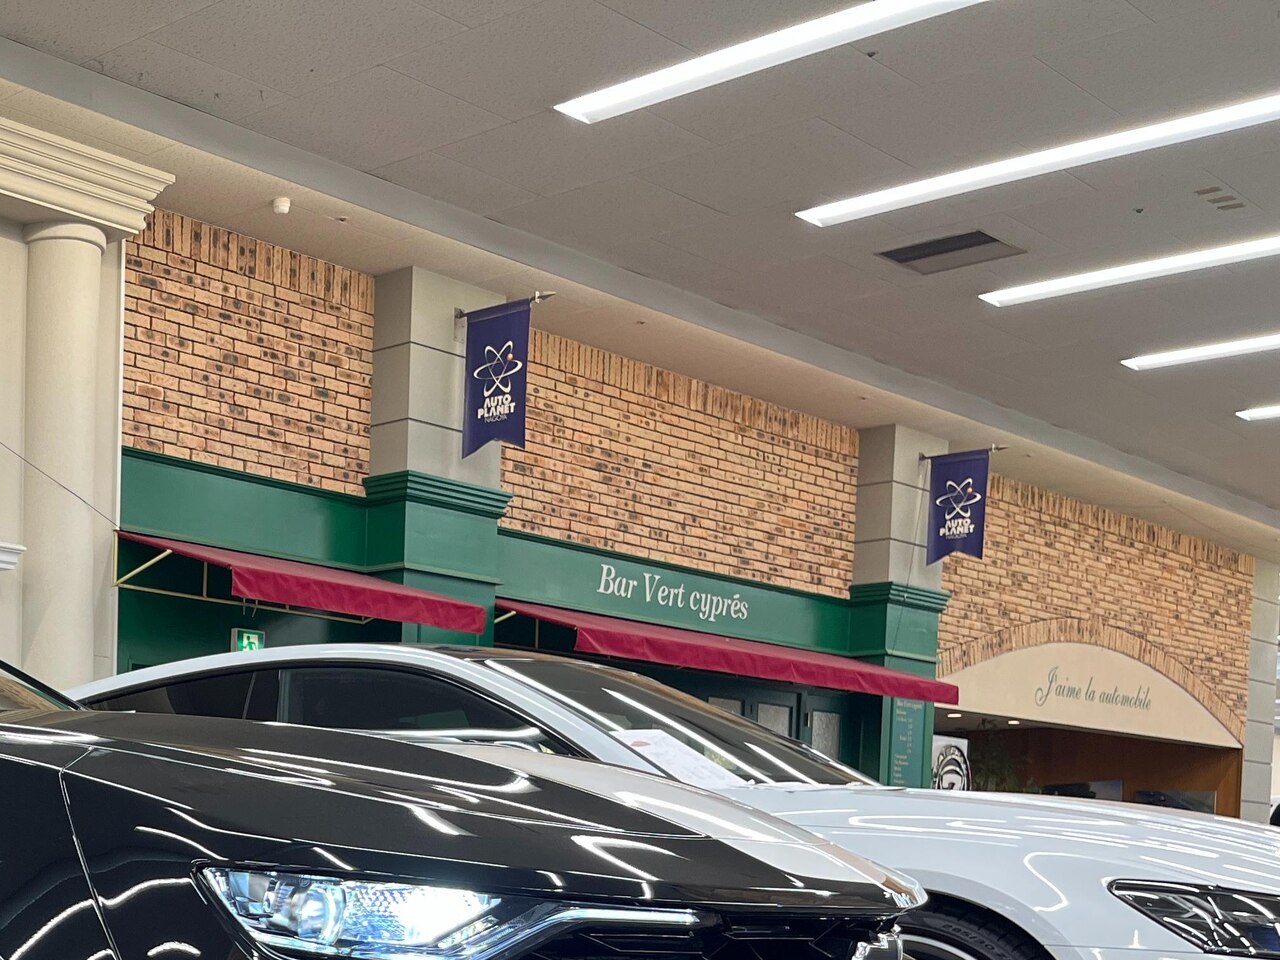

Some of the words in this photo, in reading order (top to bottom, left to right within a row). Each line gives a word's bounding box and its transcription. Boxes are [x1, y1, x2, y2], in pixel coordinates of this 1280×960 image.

[483, 394, 512, 408] AUTO
[477, 402, 516, 419] PLANET
[939, 524, 975, 536] PLANET
[945, 518, 971, 529] AUTO
[596, 563, 638, 599] Bar
[642, 572, 685, 608] Vert
[689, 593, 749, 622] cyprés
[1034, 666, 1082, 707] J'aime
[1084, 676, 1096, 703] la
[1098, 685, 1152, 711] automobile
